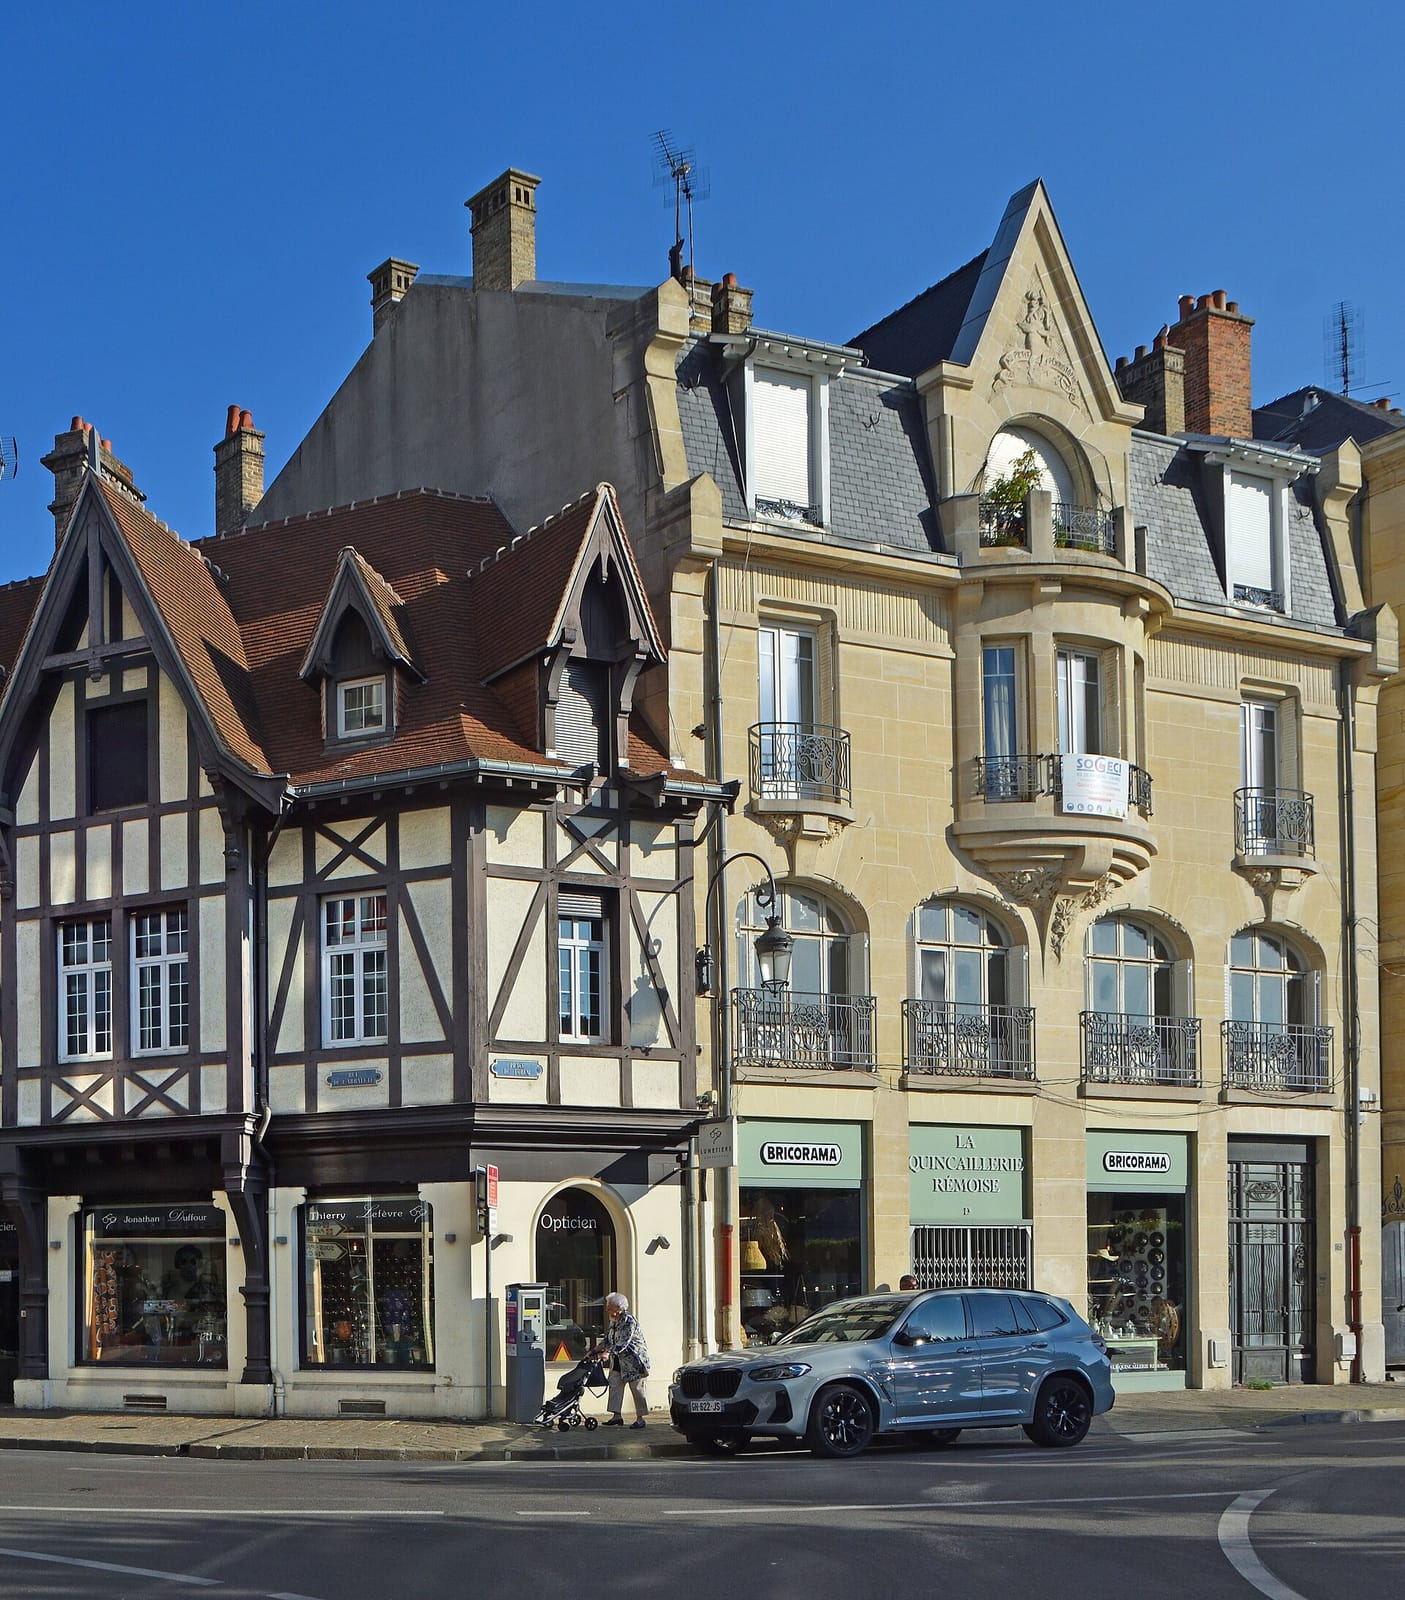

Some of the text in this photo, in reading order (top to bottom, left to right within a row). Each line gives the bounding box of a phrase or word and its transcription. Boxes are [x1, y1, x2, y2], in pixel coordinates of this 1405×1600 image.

[1076, 757, 1122, 774] SOGECI
[955, 1135, 976, 1149] LA
[767, 1146, 838, 1162] BRICORAMA
[908, 1155, 1024, 1174] QUINCAILLERIE
[1108, 1155, 1167, 1170] BRICORAMA
[932, 1175, 1001, 1193] RÉMOISE
[123, 1208, 207, 1224] Jonathan Duffour
[308, 1211, 346, 1222] Thierry
[541, 1214, 597, 1232] Opticien
